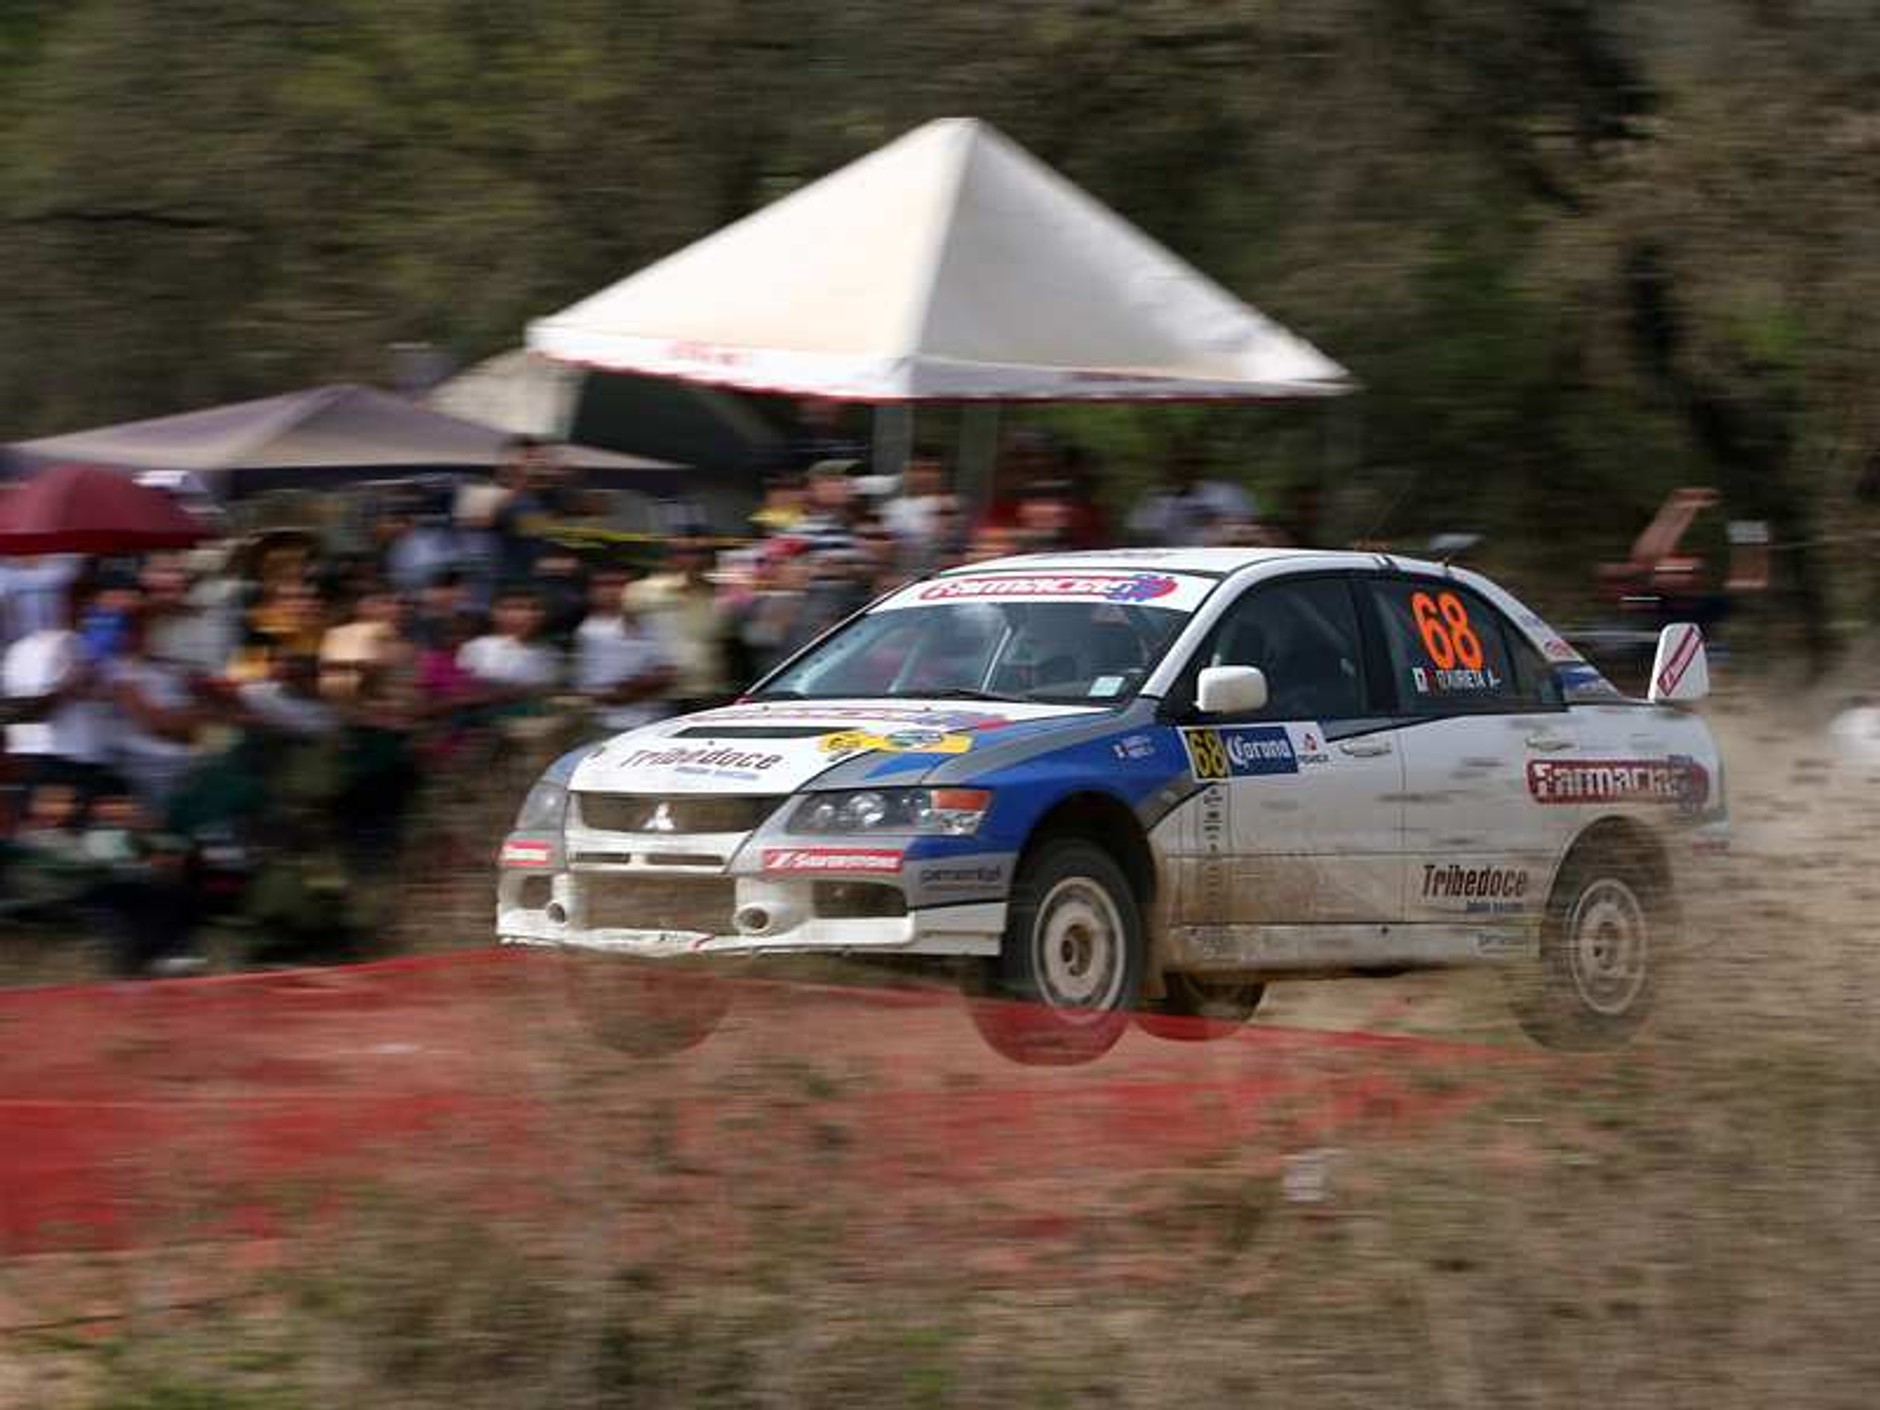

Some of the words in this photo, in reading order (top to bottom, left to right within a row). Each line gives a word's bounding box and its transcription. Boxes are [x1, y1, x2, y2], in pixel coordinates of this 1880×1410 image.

[1412, 592, 1484, 671] 68
[1190, 732, 1227, 777] 68
[1228, 733, 1292, 769] Corona
[1423, 864, 1528, 897] Tribedoce
